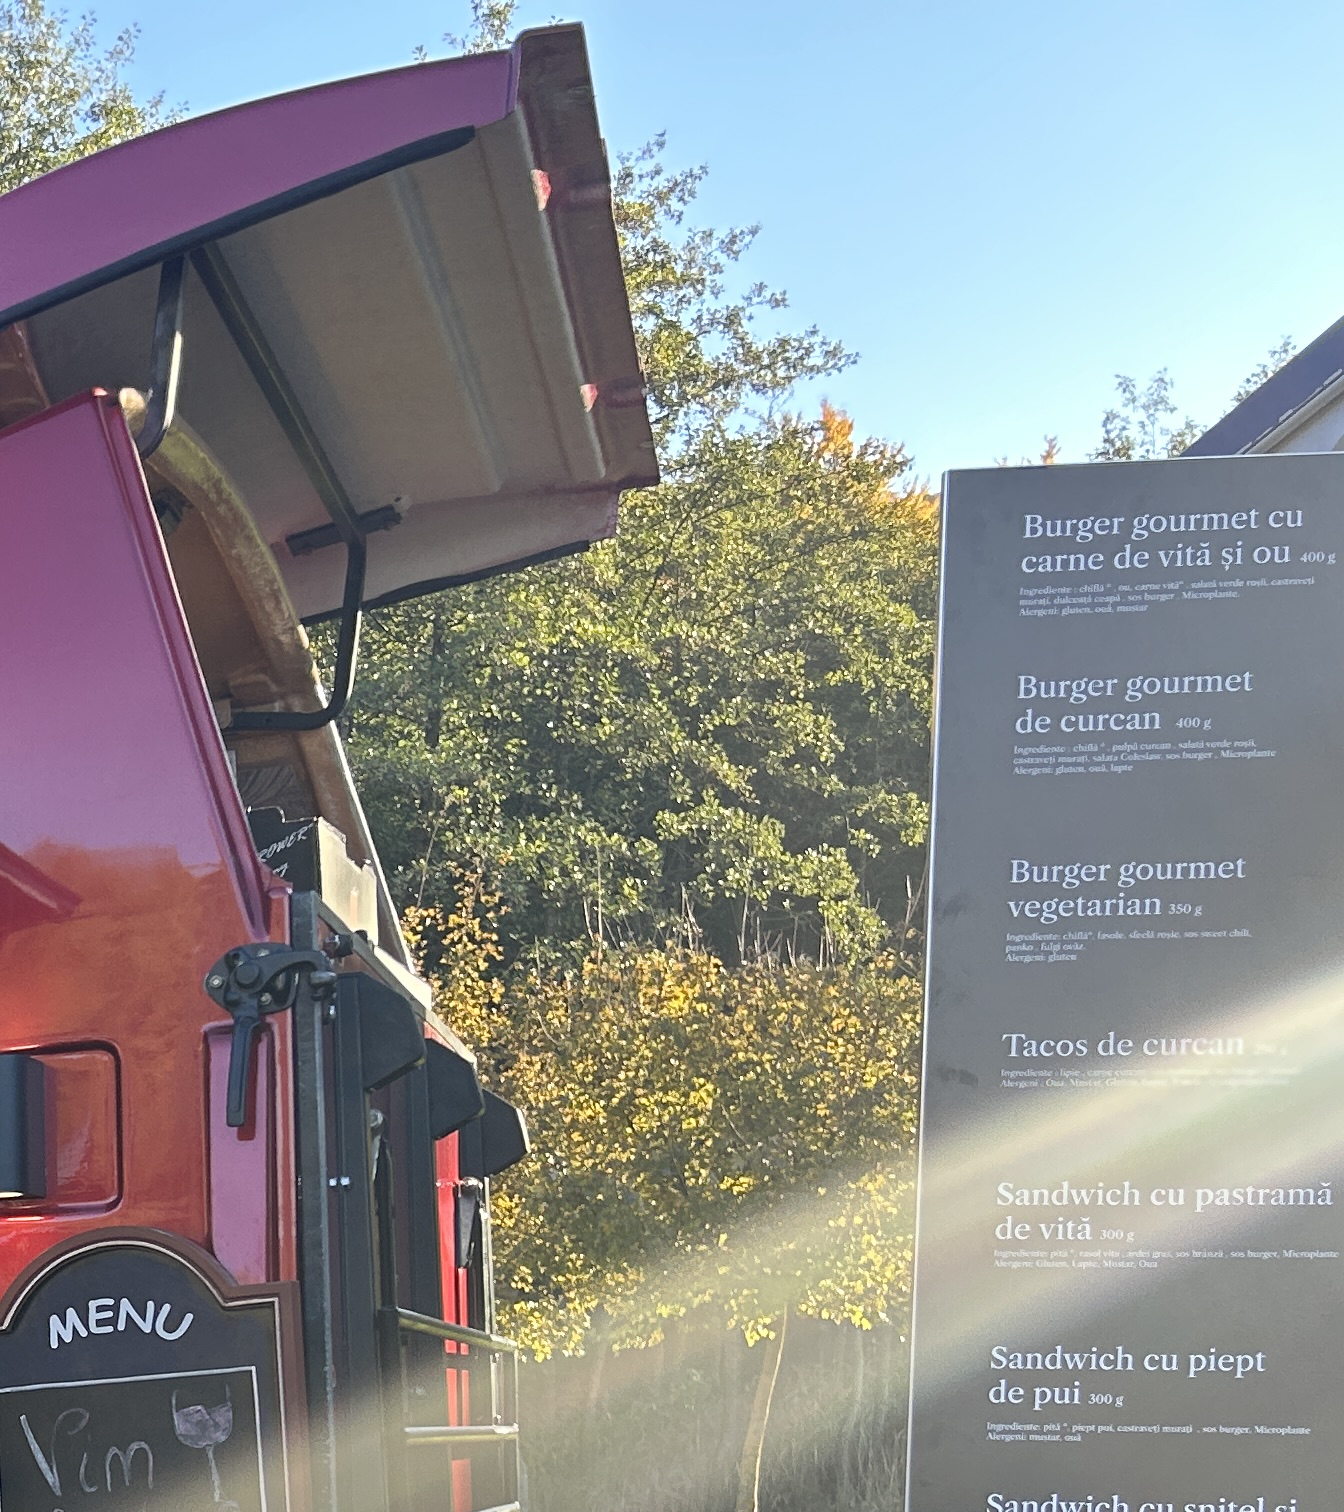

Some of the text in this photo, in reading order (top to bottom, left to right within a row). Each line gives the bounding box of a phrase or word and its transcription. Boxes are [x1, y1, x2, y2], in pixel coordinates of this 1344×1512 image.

[1022, 508, 1303, 543] Burger gourmet cu
[1021, 540, 1337, 573] carne de vită și ou 400 g
[1017, 671, 1254, 705] Burger gourmet
[1015, 708, 1212, 734] de curcan 400 g
[1009, 858, 1247, 889] Burger gourmet
[1007, 892, 1203, 925] vegetarian 350 g
[1001, 1033, 1088, 1057] Tacos
[1097, 1031, 1137, 1060] de
[1142, 1036, 1245, 1057] curcan
[996, 1180, 1334, 1213] Sandwich cu pastramă
[994, 1215, 1135, 1243] de vită 300 g
[48, 1297, 194, 1349] MENU
[990, 1345, 1266, 1379] Sandwich cu piept
[988, 1378, 1125, 1411] de pui 300 g
